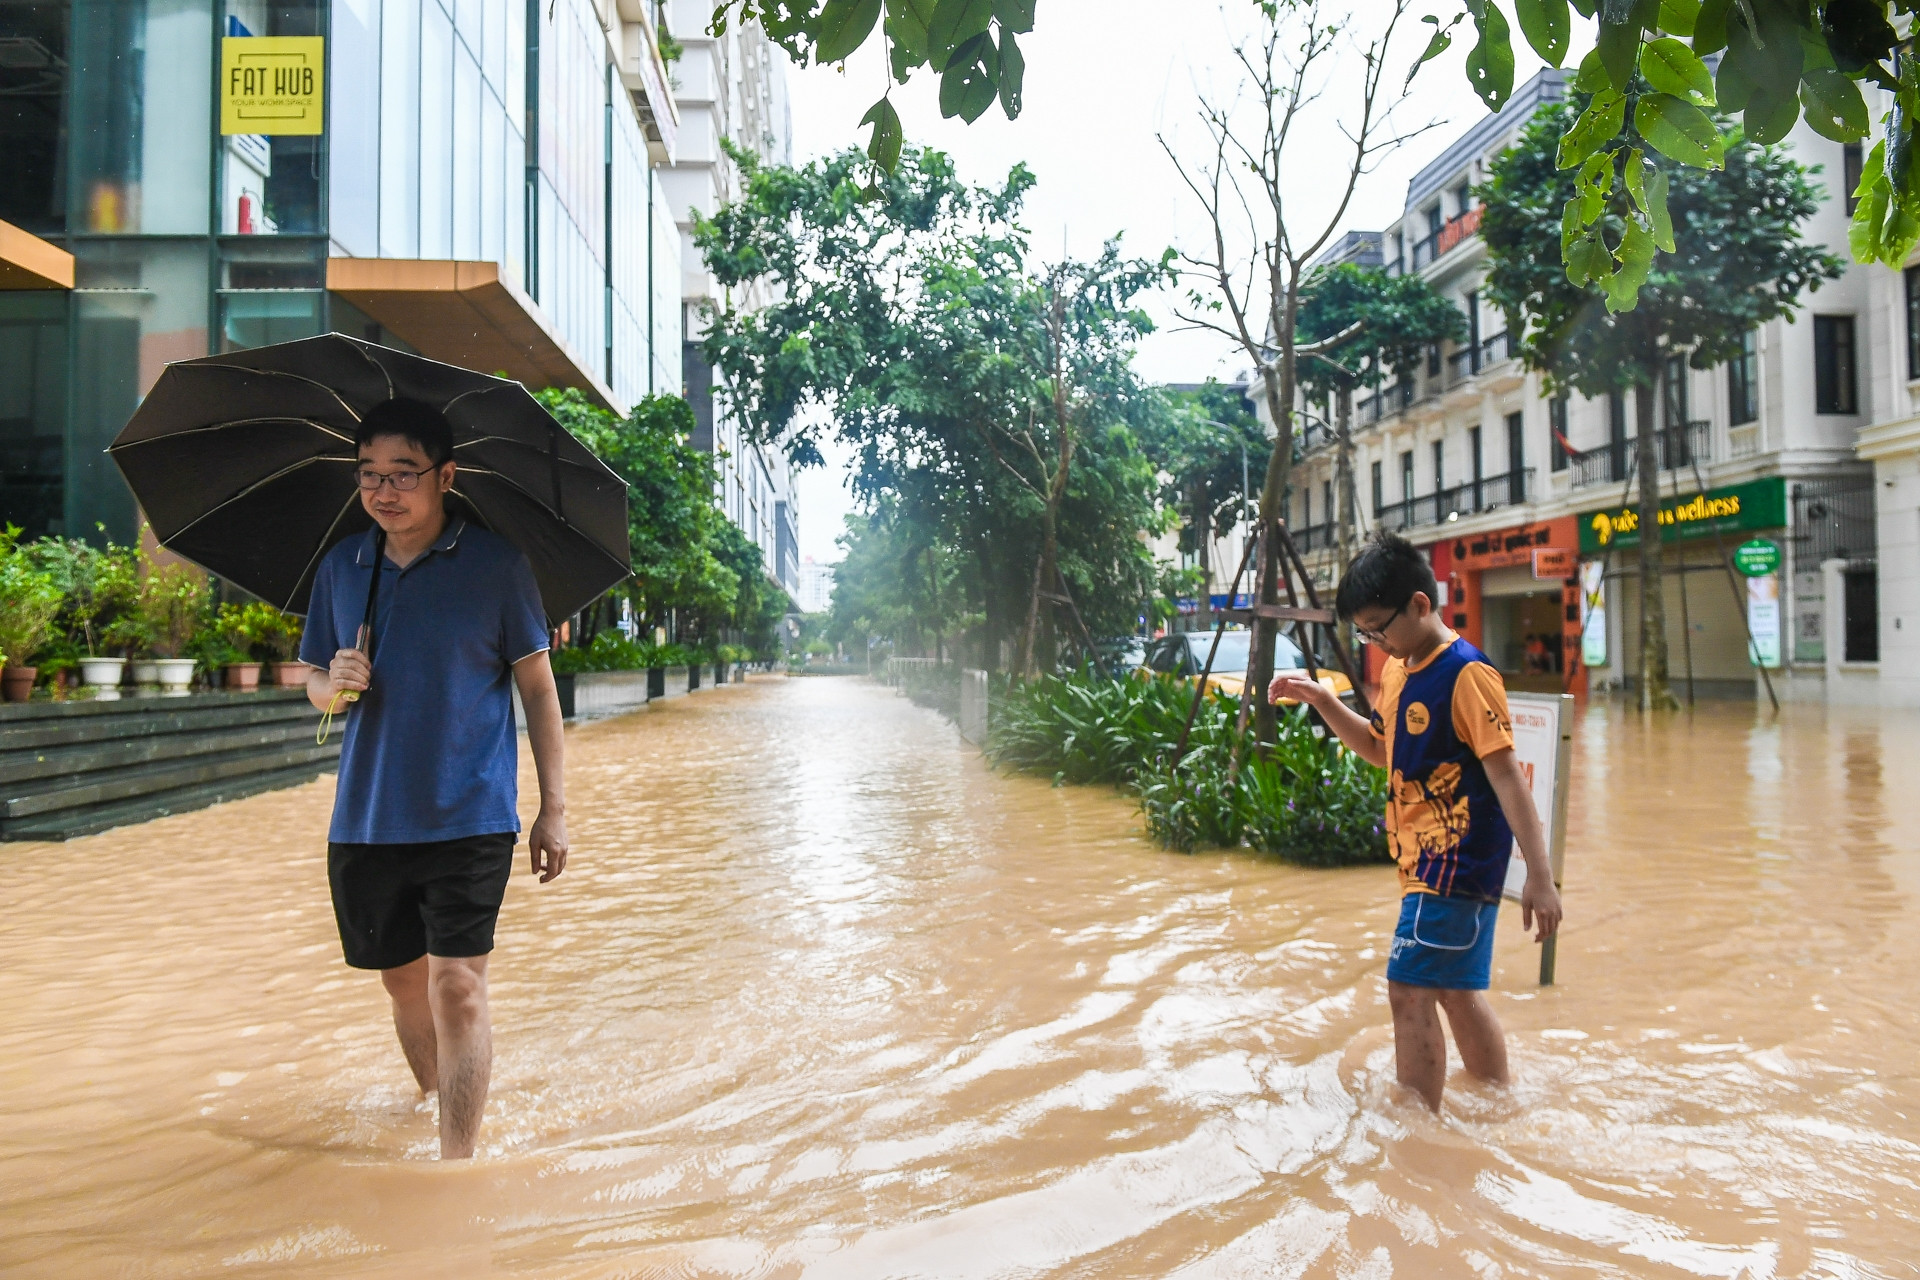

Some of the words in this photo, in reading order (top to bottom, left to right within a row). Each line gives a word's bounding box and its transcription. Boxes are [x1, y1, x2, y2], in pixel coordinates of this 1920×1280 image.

[231, 67, 267, 96] FAT
[275, 67, 313, 96] HUB
[1676, 494, 1740, 522] wellness
